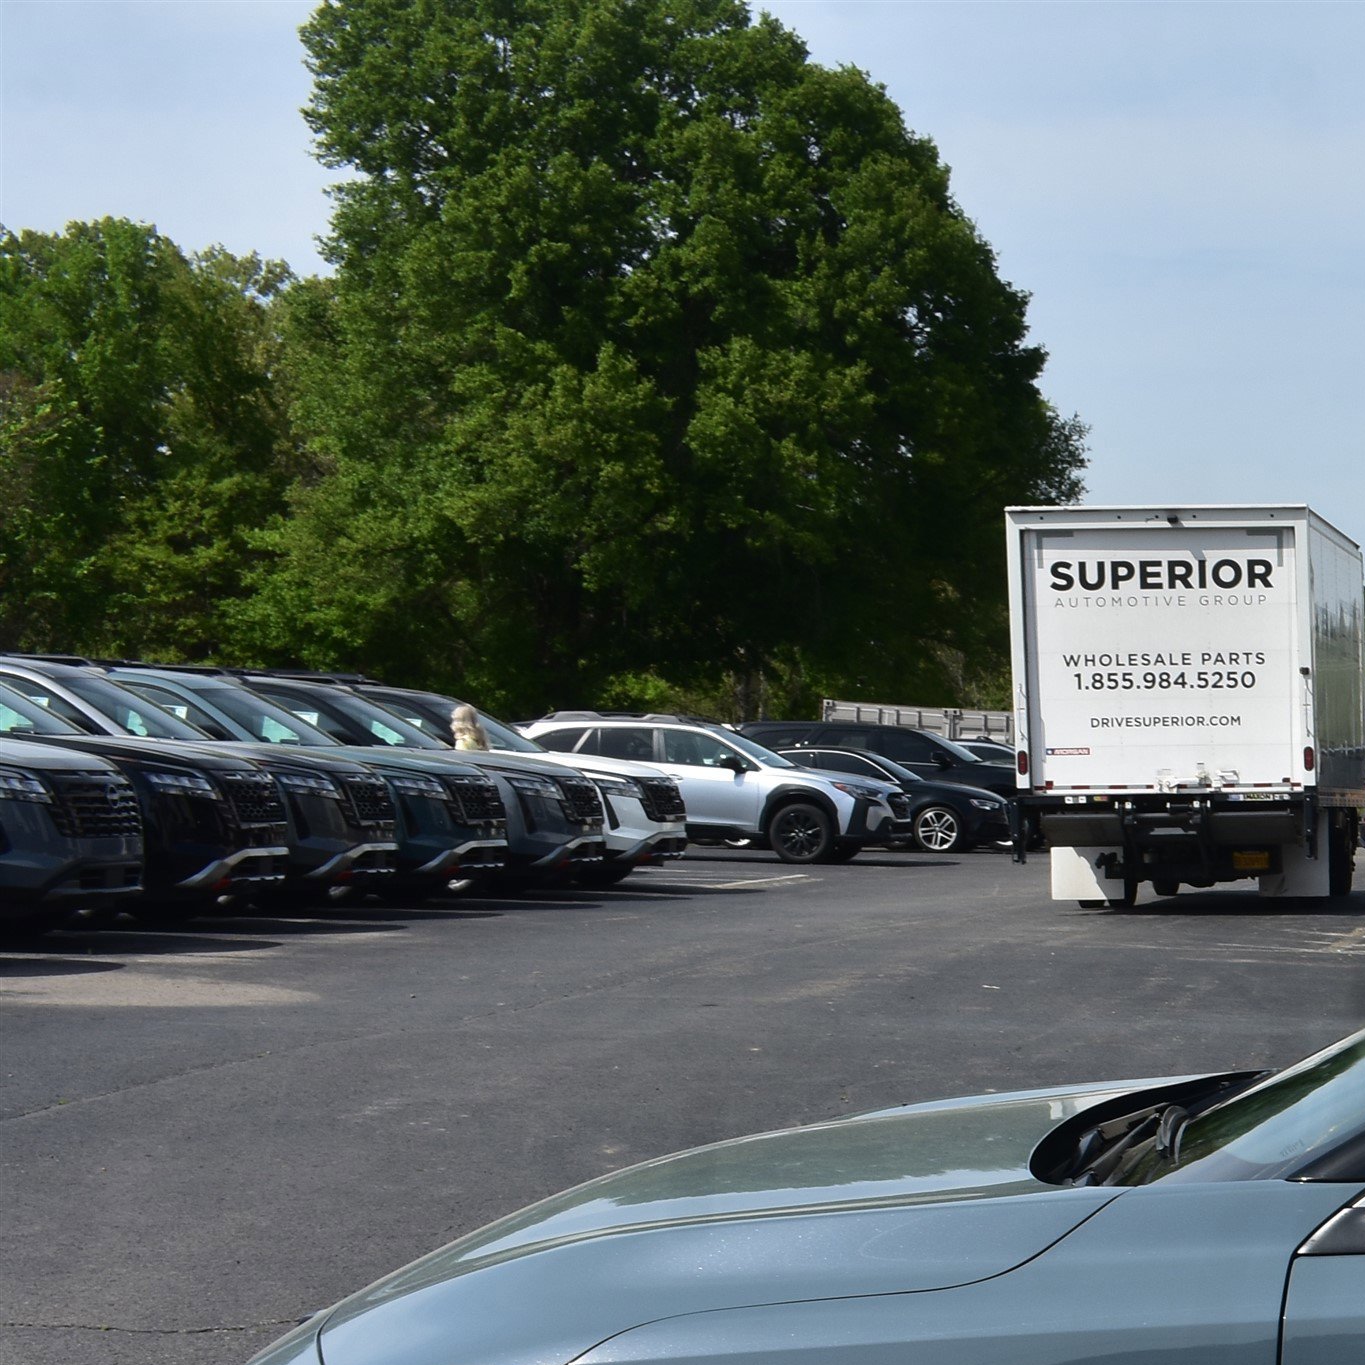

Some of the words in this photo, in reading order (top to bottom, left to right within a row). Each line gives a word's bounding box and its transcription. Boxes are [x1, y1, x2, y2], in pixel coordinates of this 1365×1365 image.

[1050, 558, 1274, 591] SUPERIOR
[1054, 595, 1187, 608] AUTOMOTIVE
[1199, 594, 1267, 606] GROUP
[1062, 652, 1192, 667] WHOLESALE
[1201, 652, 1266, 665] PARTS
[1074, 671, 1256, 690] 1.855.984.5250
[1090, 715, 1241, 728] DRIVESUPERIOR.COM
